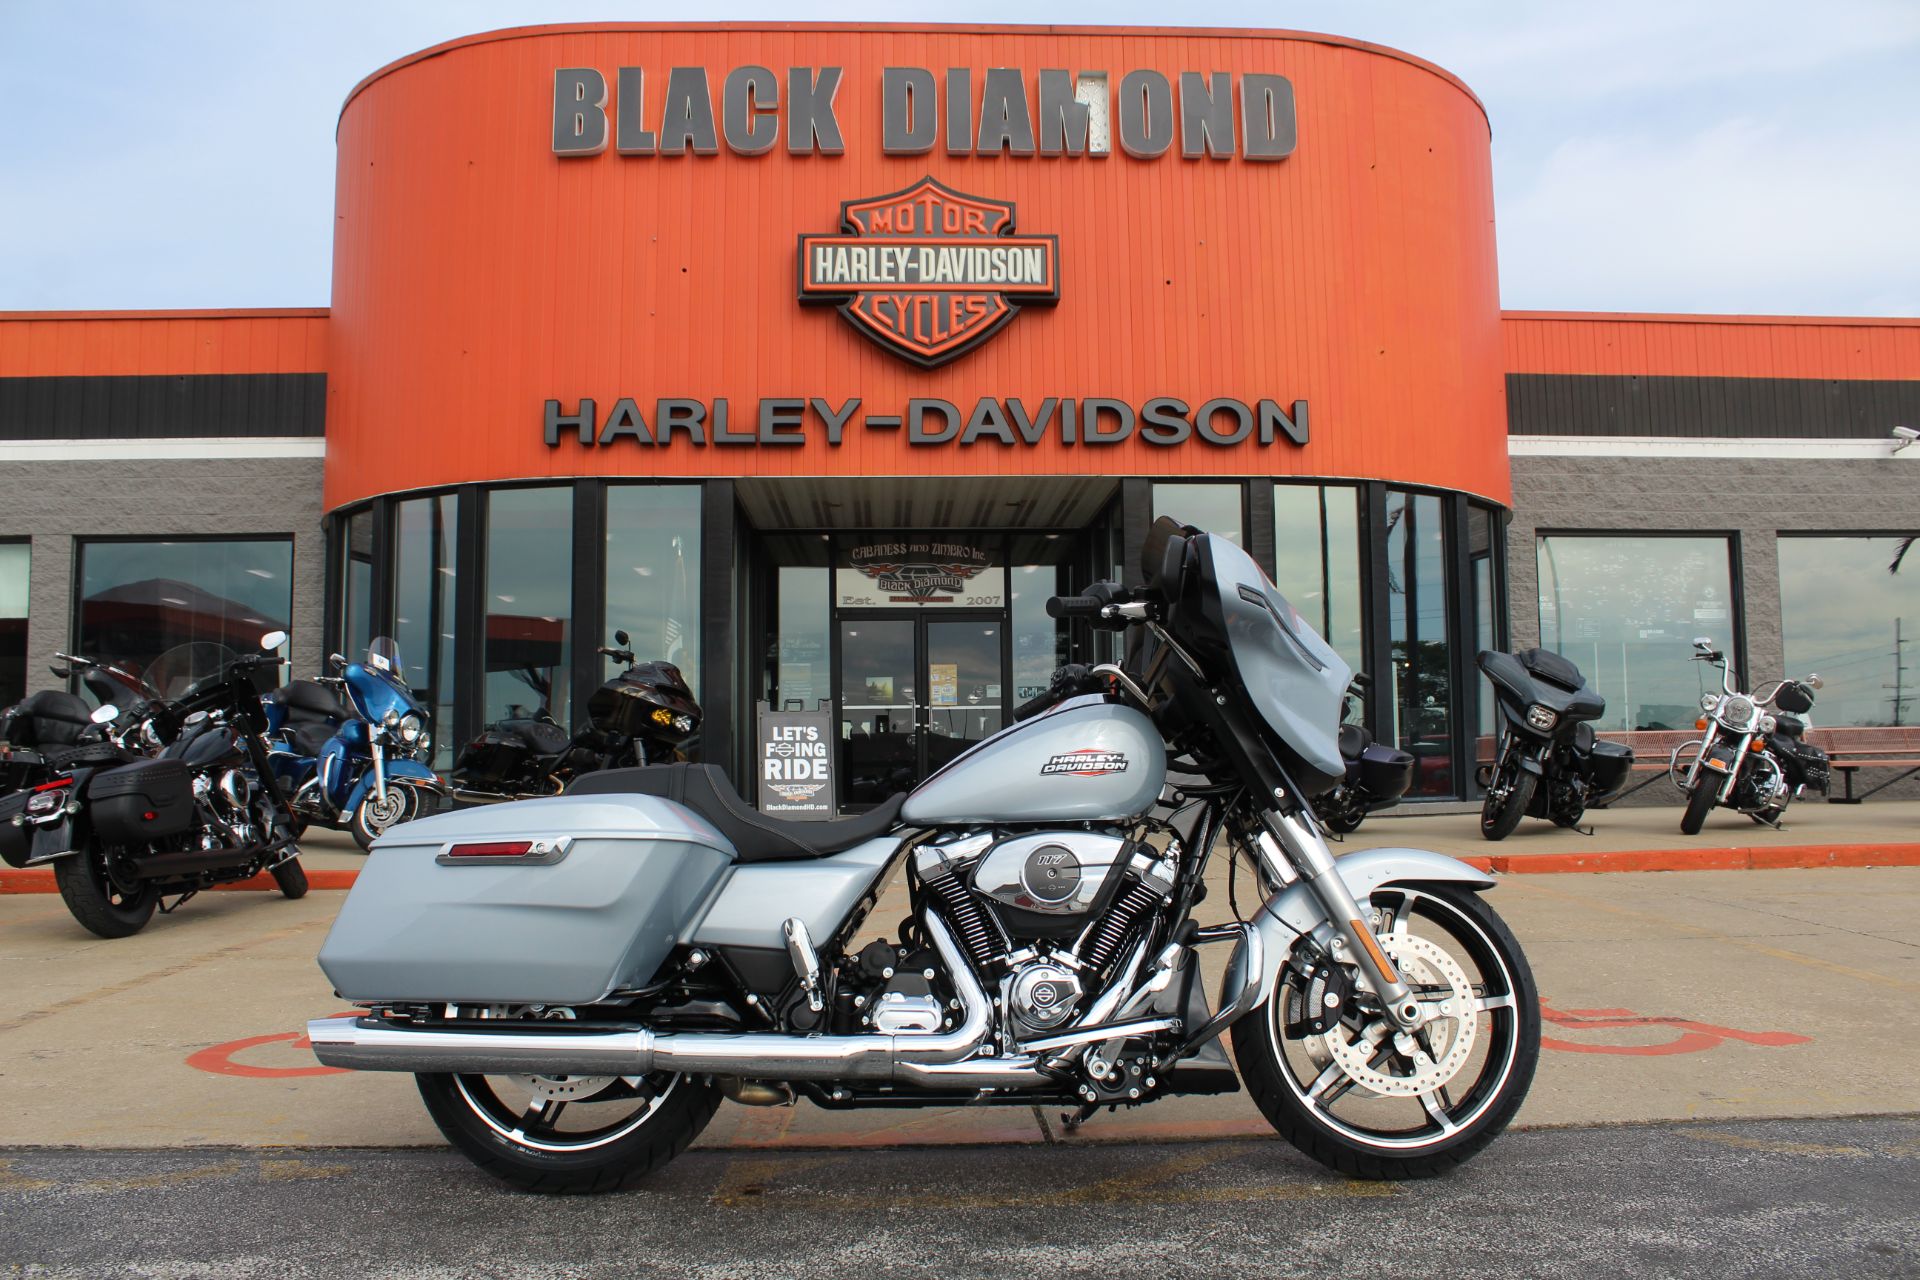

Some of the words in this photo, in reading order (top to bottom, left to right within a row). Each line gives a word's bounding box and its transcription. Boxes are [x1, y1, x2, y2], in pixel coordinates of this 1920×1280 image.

[552, 65, 845, 156] BLACK
[882, 66, 1298, 161] DIAMOND
[870, 195, 988, 235] MOTOR
[815, 246, 1042, 284] HARLEY-DAVIDSON
[870, 294, 989, 346] CYCLES
[543, 397, 1311, 448] HARLEY-DAVIDSON
[966, 596, 1001, 606] 2007
[772, 726, 819, 741] LET'S
[765, 758, 829, 780] RIDE
[1043, 761, 1127, 773] DAVIDSON
[1037, 854, 1068, 866] 117
